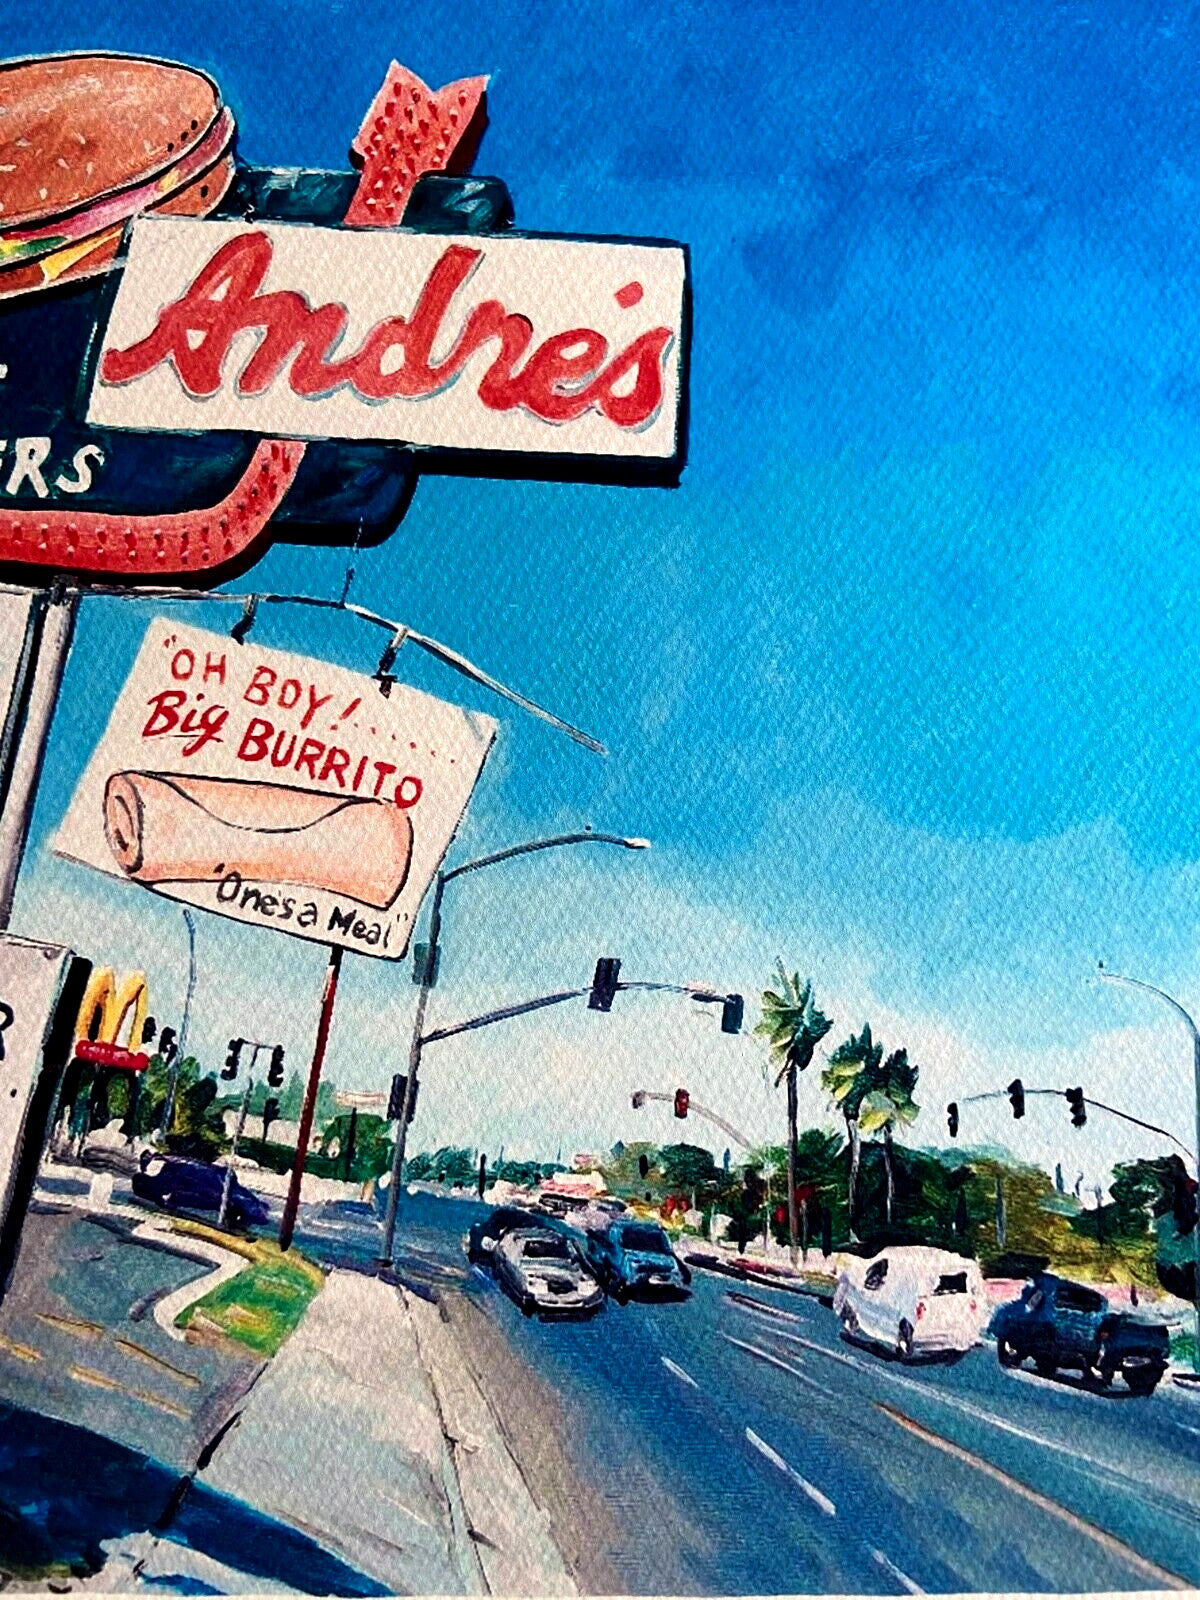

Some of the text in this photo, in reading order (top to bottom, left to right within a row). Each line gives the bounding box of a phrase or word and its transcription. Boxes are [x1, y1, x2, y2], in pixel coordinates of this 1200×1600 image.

[101, 231, 673, 431] Andre's
[0, 436, 105, 498] RS
[141, 689, 424, 809] Big BURRITO
